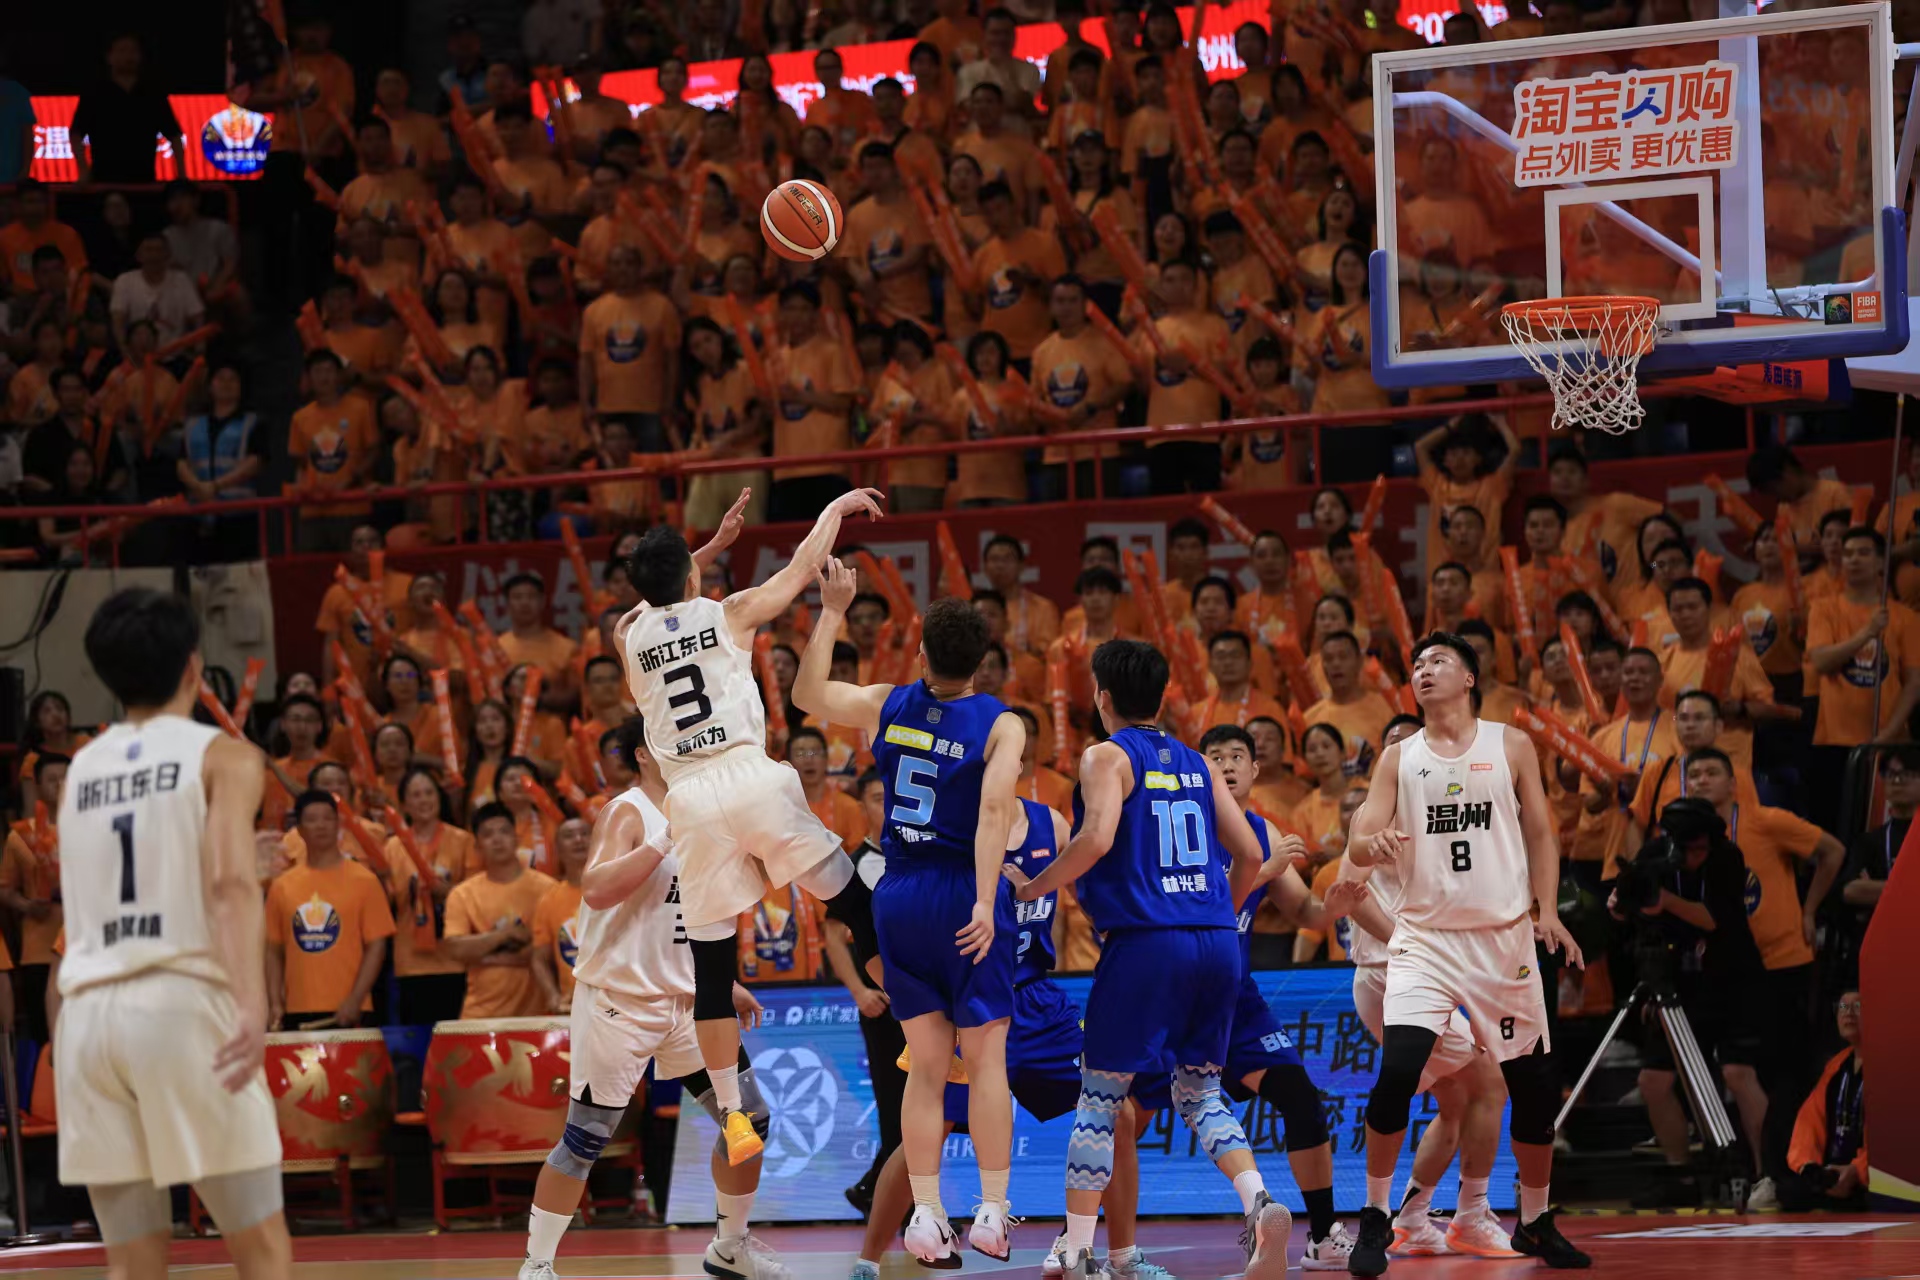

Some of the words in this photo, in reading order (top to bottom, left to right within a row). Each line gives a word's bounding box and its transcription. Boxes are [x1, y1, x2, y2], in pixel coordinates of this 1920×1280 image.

[1516, 67, 1733, 139] 淘宝闪购
[1520, 136, 1621, 181] 点外卖
[1631, 125, 1733, 170] 更优惠
[1857, 295, 1877, 307] FIBA
[637, 626, 719, 674] 浙江东日
[663, 663, 712, 732] 3
[77, 761, 181, 813] 浙江东日
[891, 754, 939, 826] 5
[1151, 799, 1209, 868] 10
[1426, 801, 1493, 835] 温州
[111, 811, 137, 905] 1
[1450, 840, 1472, 873] 8
[1259, 1029, 1293, 1053] 86
[1286, 1009, 1381, 1074] 中路
[1500, 1016, 1516, 1041] 8
